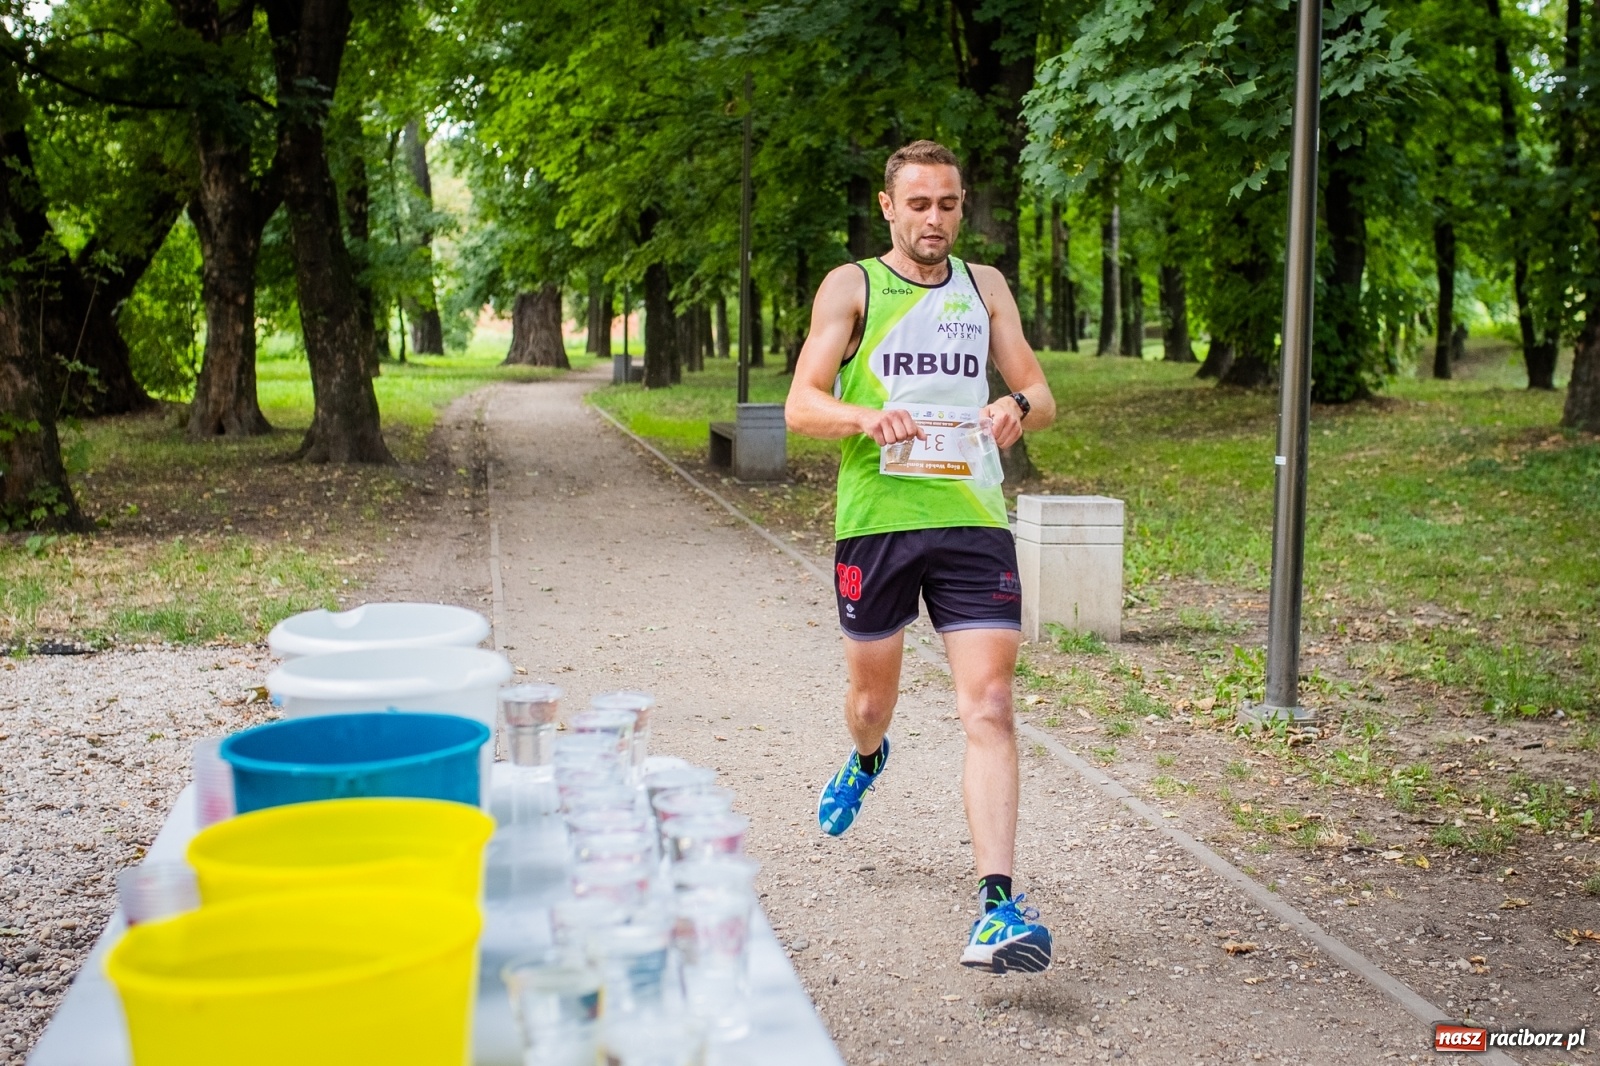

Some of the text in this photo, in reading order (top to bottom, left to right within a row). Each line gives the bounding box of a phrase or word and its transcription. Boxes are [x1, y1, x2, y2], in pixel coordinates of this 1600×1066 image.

[882, 287, 913, 296] deep
[947, 331, 976, 340] LYSKI
[883, 353, 979, 378] IRBUD
[924, 433, 946, 452] 31
